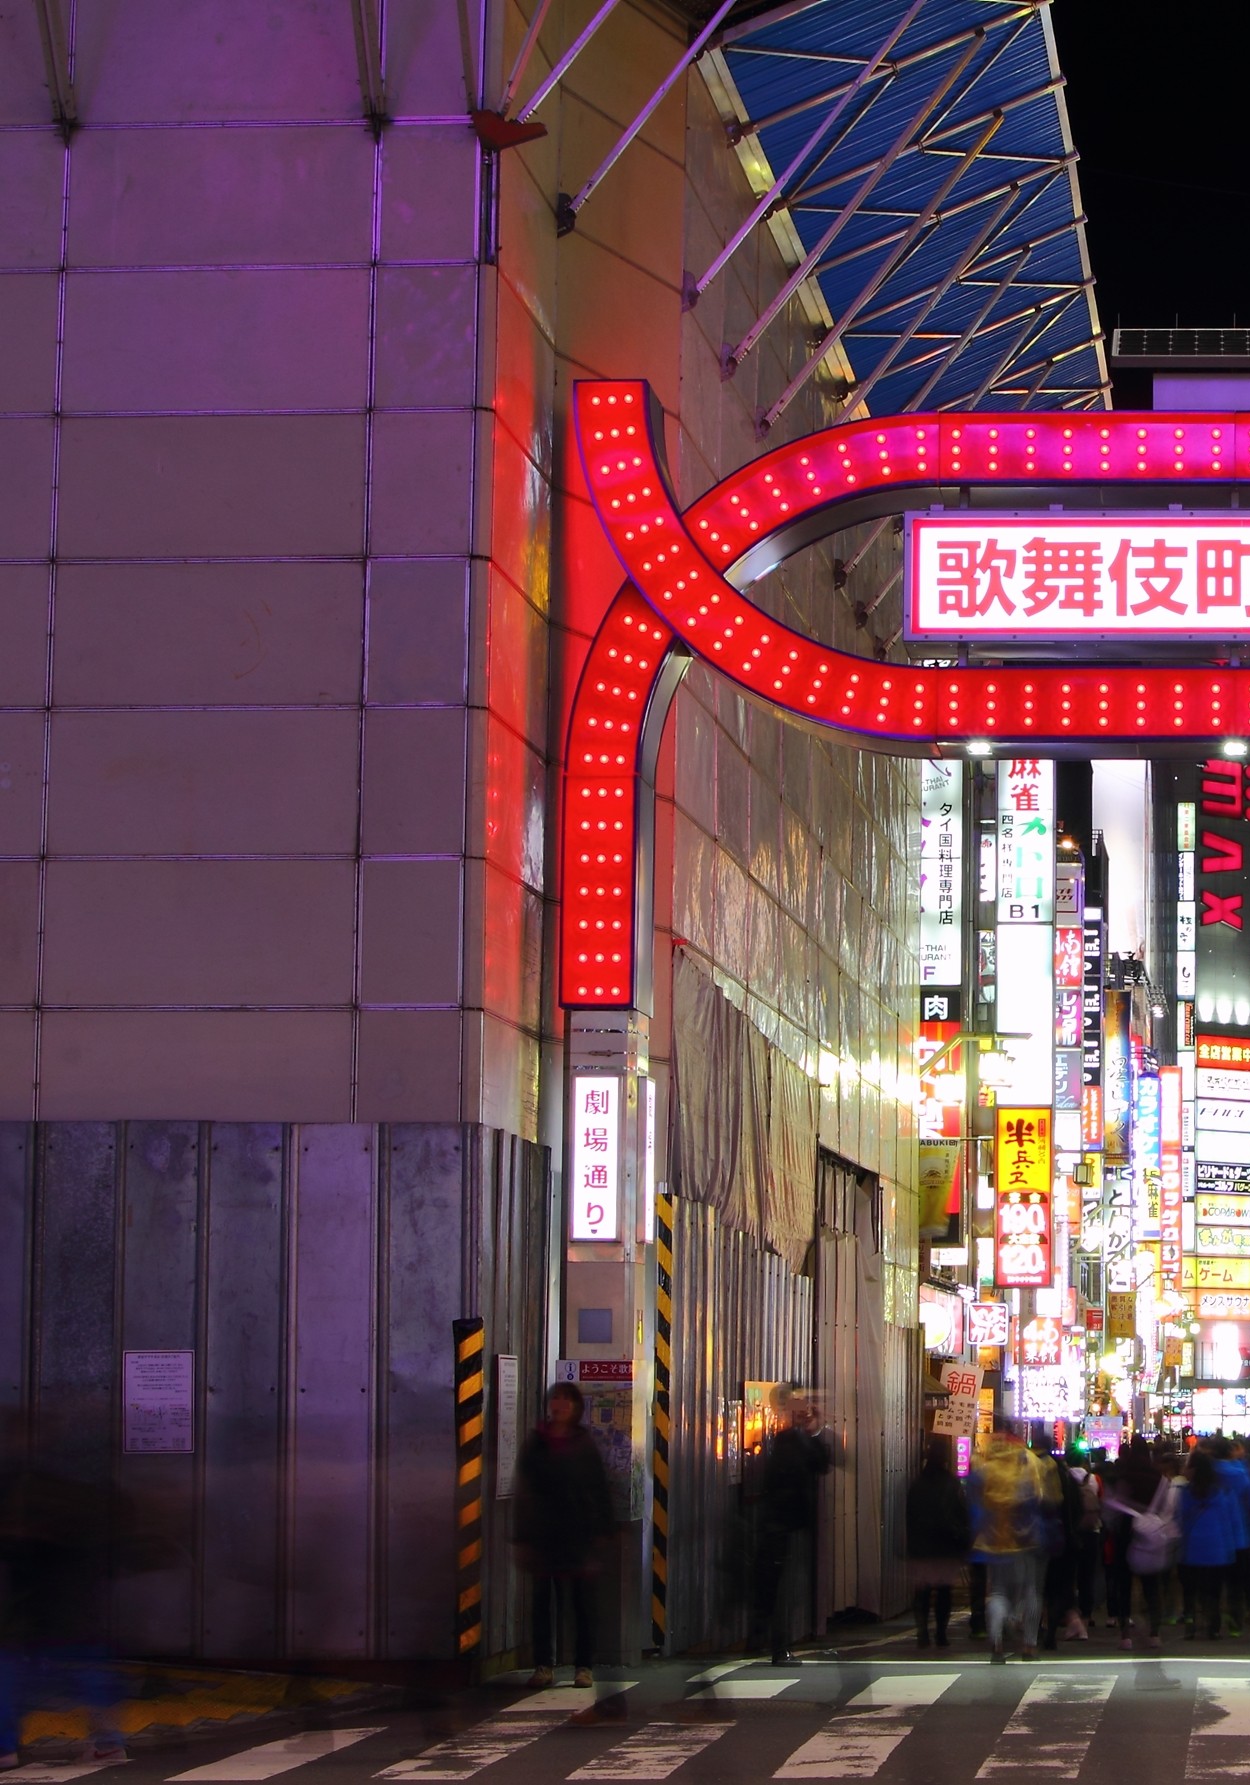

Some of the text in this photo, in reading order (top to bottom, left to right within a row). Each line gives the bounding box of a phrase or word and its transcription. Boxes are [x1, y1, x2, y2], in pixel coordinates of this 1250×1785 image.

[1008, 759, 1041, 811] 麻雀
[939, 803, 953, 925] タイ国料理専門店
[1009, 904, 1040, 918] B1
[924, 995, 949, 1021] 肉
[584, 1090, 609, 1225] 劇場通り
[947, 1371, 976, 1398] 鍋
